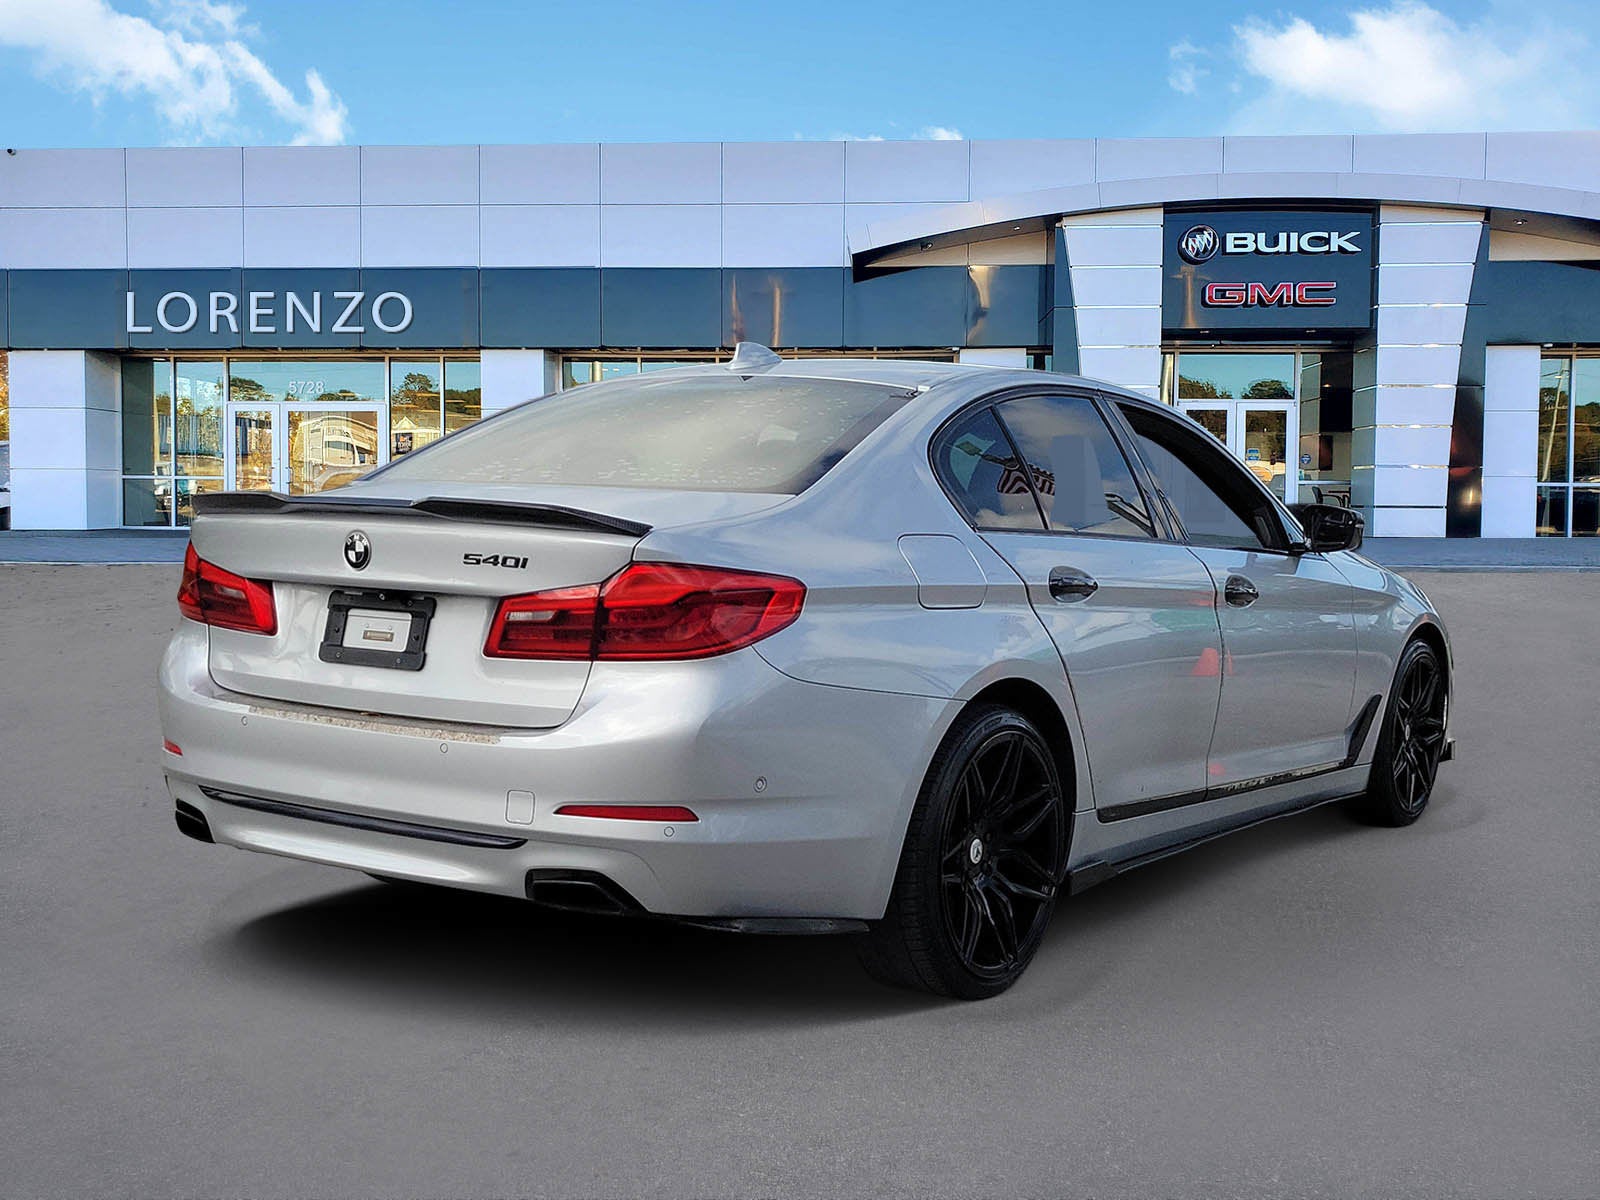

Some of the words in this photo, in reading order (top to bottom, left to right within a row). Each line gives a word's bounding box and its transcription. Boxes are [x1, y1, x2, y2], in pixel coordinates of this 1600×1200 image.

[1225, 231, 1362, 254] BUICK
[1206, 281, 1337, 305] GMC
[126, 291, 414, 334] LORENZO
[288, 380, 325, 394] 5728
